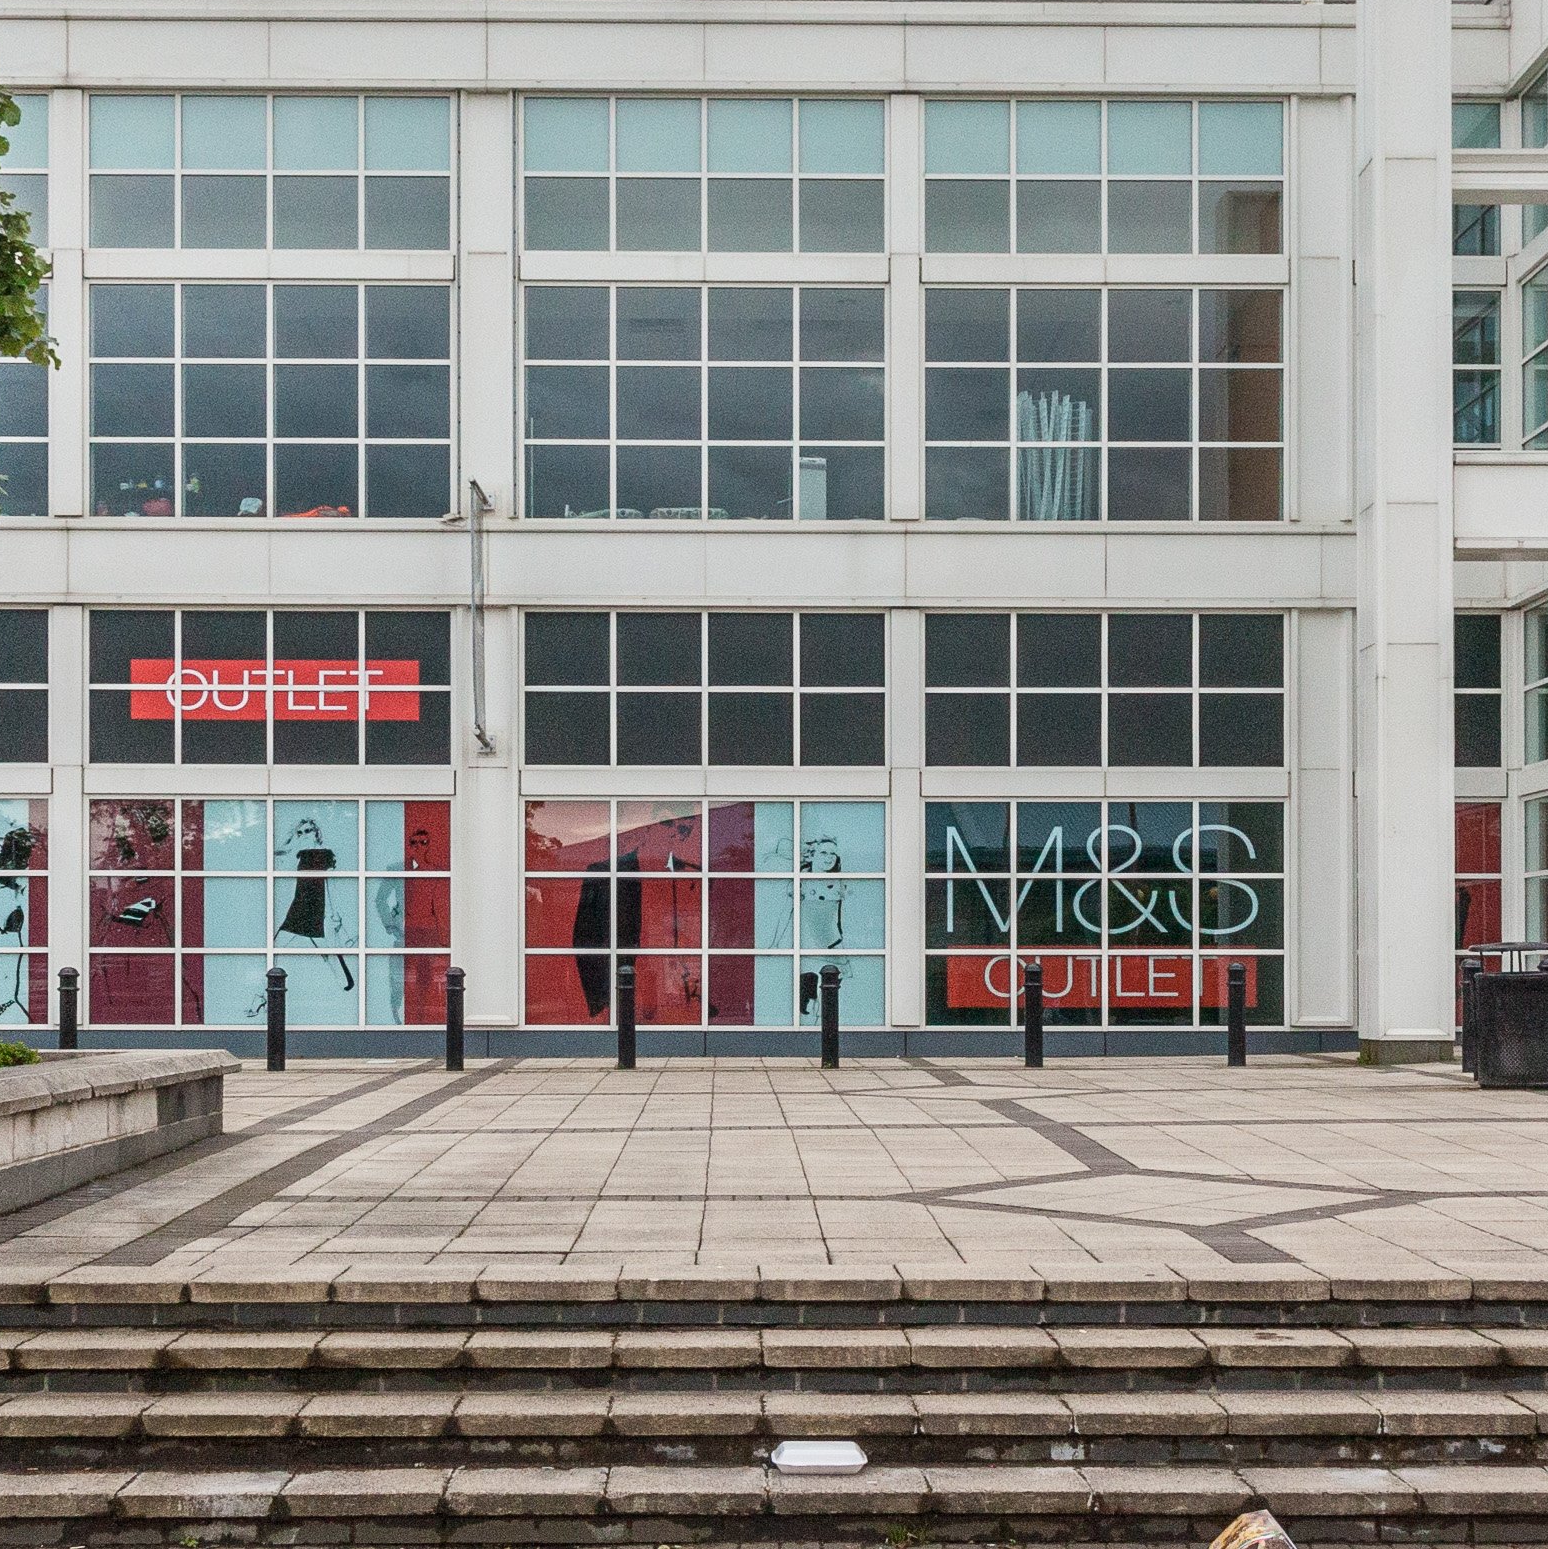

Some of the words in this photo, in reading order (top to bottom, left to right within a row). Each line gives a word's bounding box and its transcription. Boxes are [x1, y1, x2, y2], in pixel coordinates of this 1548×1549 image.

[165, 668, 384, 711] OUTLET
[946, 824, 1259, 935] M&S
[984, 955, 1218, 998] OUTLET
